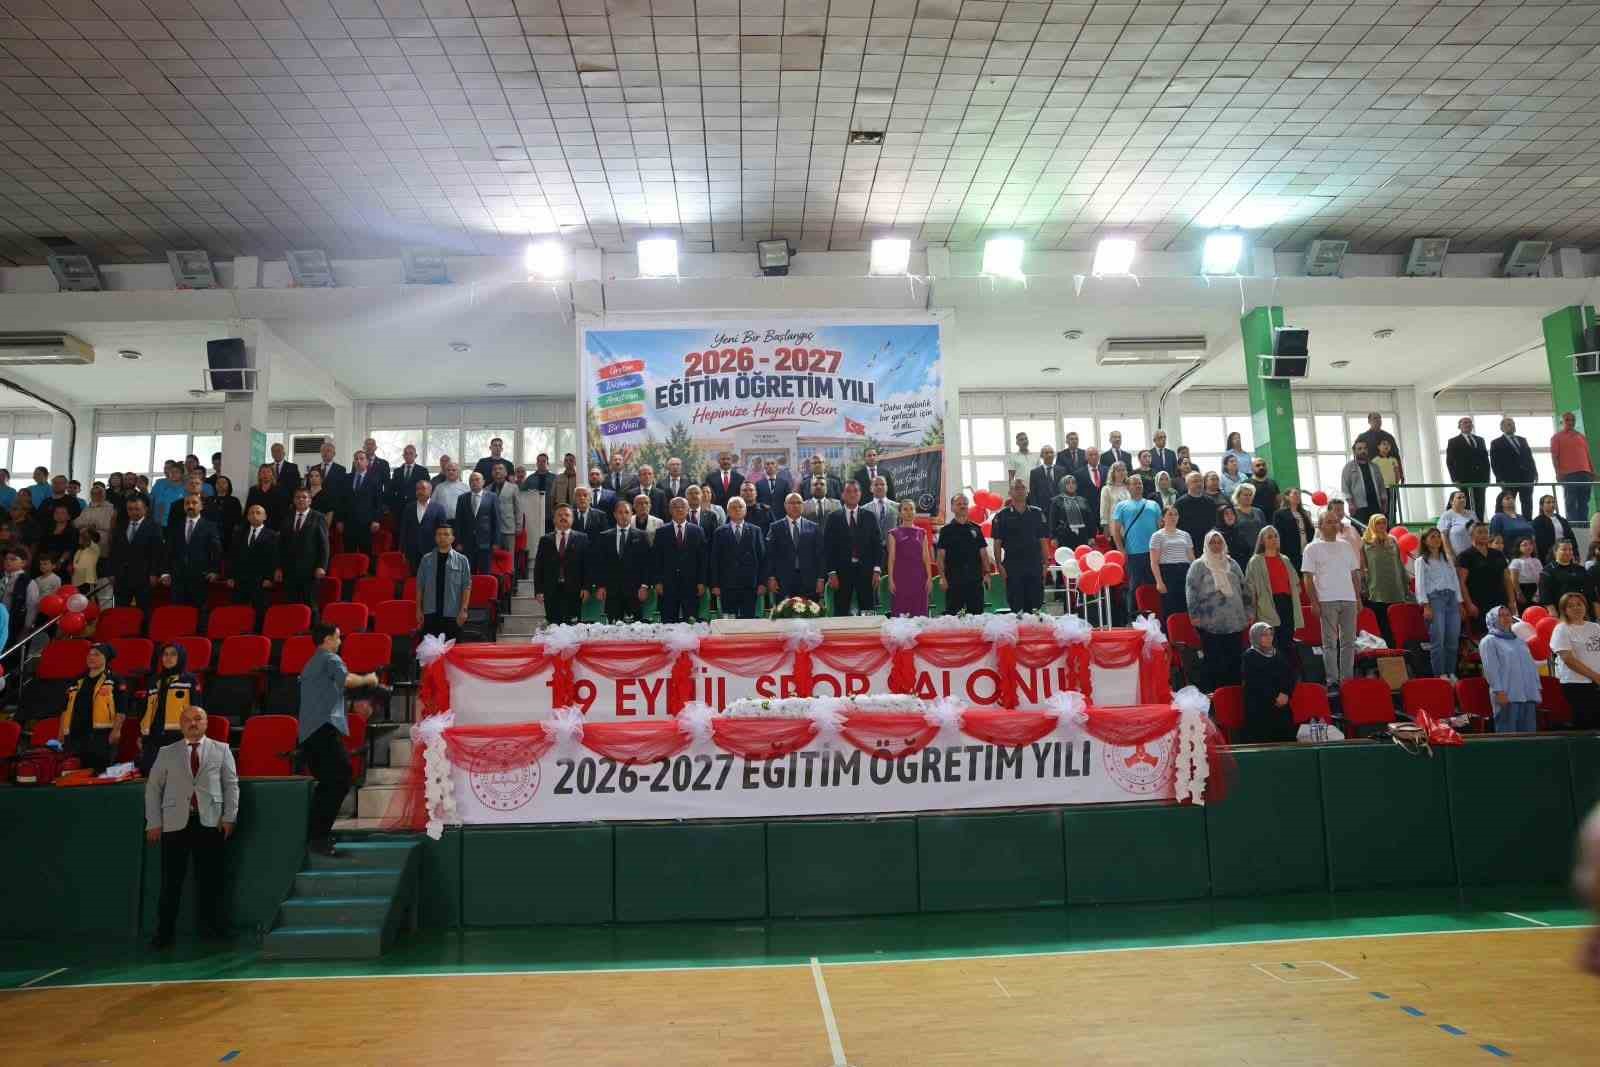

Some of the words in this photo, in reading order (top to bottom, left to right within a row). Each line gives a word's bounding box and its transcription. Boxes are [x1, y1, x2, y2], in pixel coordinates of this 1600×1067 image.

[711, 333, 739, 349] Yeni
[743, 331, 760, 345] Bir
[684, 347, 754, 376] 2026
[774, 347, 842, 374] 2027
[655, 376, 730, 410] EĞİTİM
[735, 371, 834, 400] ÖĞRETİM
[838, 378, 875, 405] YILI
[692, 407, 749, 425] Hepimize
[753, 403, 795, 421] Hayırlı
[800, 401, 838, 417] Olsun
[553, 753, 735, 794] 2026-2027
[1032, 740, 1091, 779] YILI
